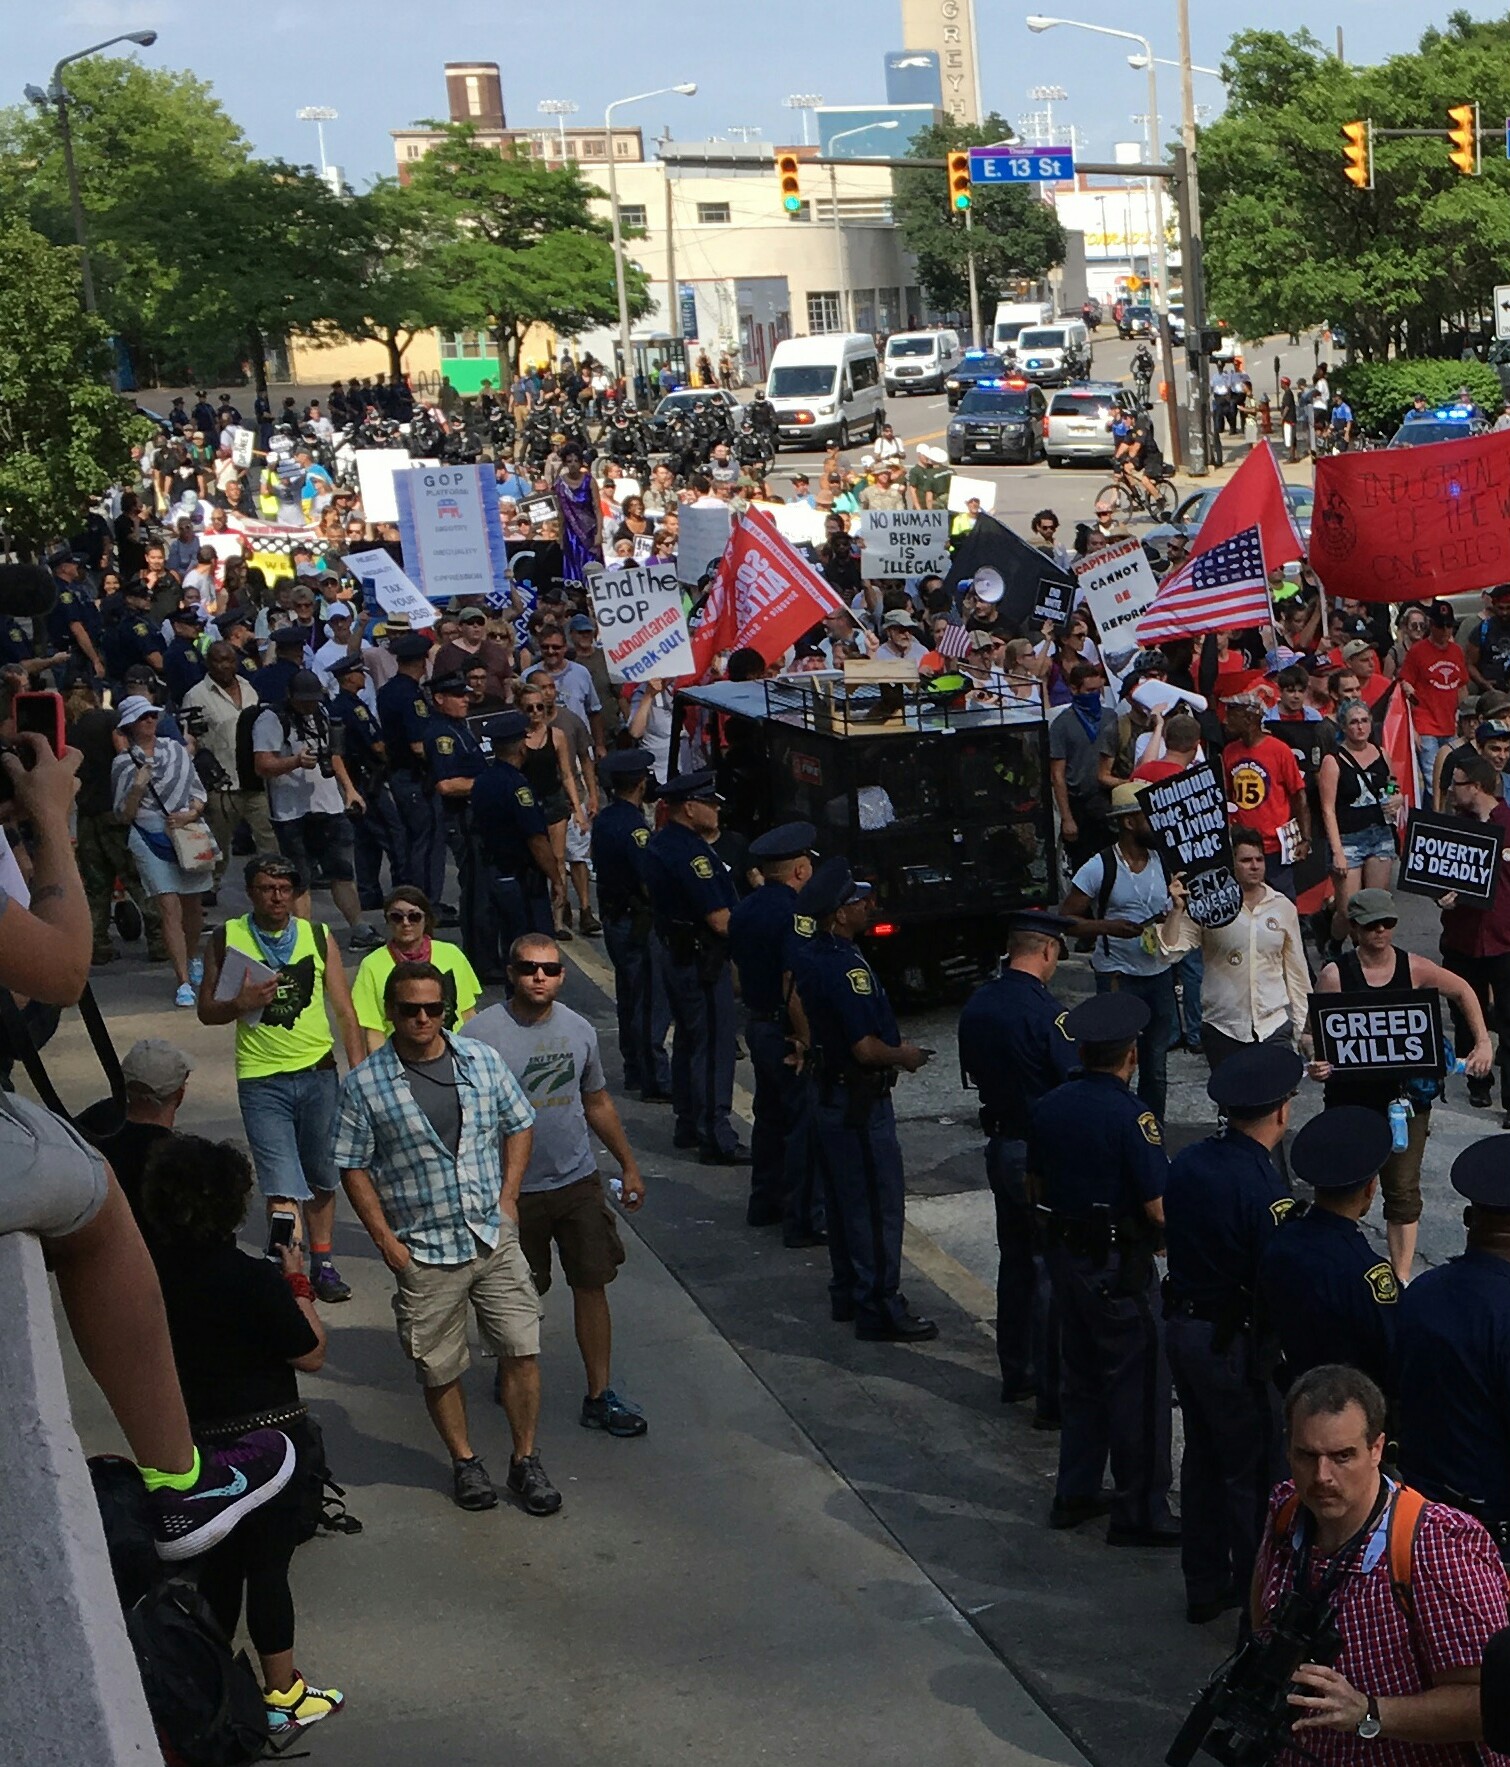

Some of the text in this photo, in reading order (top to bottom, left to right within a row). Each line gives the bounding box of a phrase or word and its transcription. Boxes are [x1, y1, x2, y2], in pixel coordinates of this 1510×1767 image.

[983, 157, 1062, 177] E. 13 St
[423, 472, 464, 488] GOP
[869, 512, 942, 530] NO HUMAN
[1439, 496, 1487, 534] THE
[889, 532, 932, 546] BEING
[900, 547, 916, 560] IS
[1439, 531, 1500, 573] BIG
[1074, 538, 1141, 577] CAPITALISM
[382, 583, 404, 594] TAX
[589, 570, 678, 601] End the
[1090, 561, 1140, 591] CANNOT
[389, 595, 418, 607] YOUR
[600, 599, 650, 628] GOP
[607, 606, 682, 664] Authoritarian
[620, 629, 687, 683] Freak-out
[1148, 769, 1216, 812] Minimum
[1149, 787, 1223, 832] Wage That's
[1164, 805, 1225, 848] a Living
[1178, 833, 1222, 865] Wage
[1415, 835, 1489, 866] POVERTY
[1408, 852, 1490, 884] IS DEADLY
[1187, 868, 1230, 900] END
[1189, 884, 1241, 916] POVERTY
[1326, 1009, 1428, 1038] GREED
[1336, 1036, 1424, 1064] KILLS
